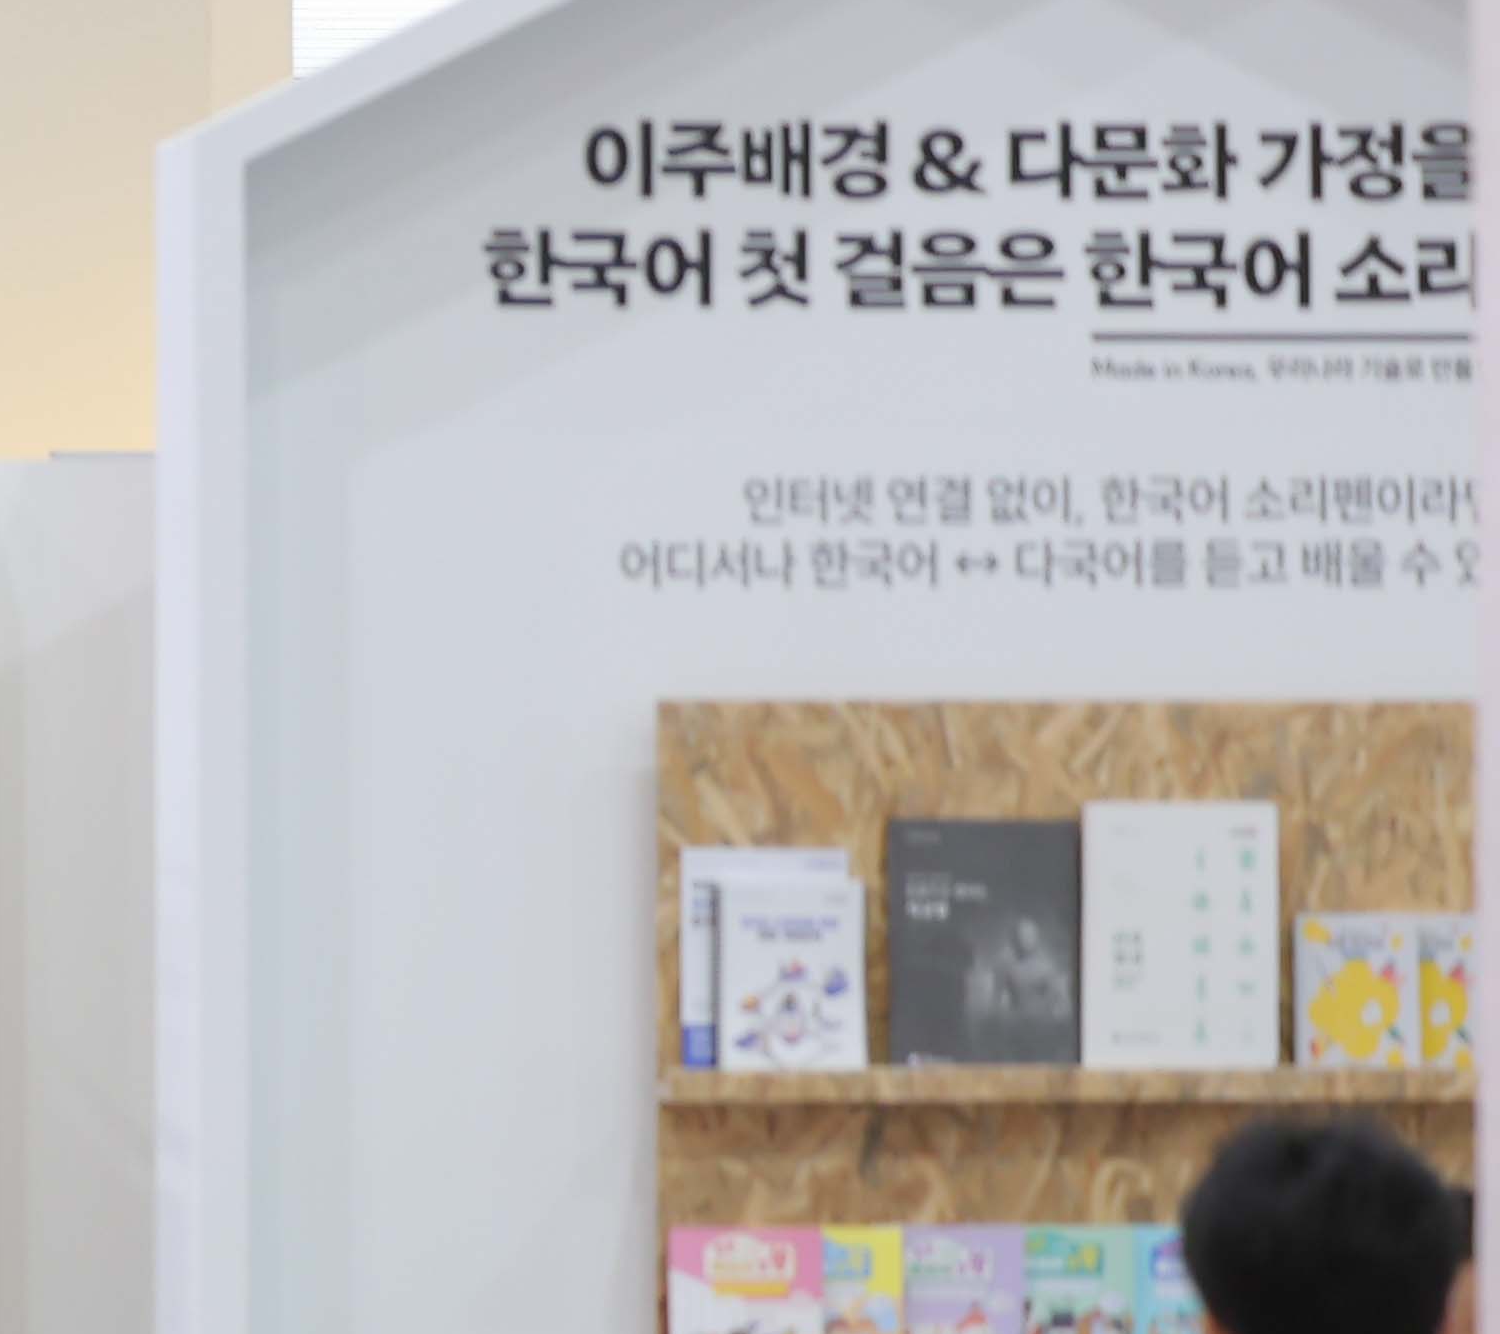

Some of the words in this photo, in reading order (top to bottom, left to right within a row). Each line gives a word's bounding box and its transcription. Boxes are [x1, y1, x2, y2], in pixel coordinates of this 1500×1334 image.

[585, 118, 892, 202] 이주배경
[912, 129, 987, 195] &
[1008, 118, 1237, 202] 다문화
[482, 227, 714, 310] 한국어
[737, 230, 810, 309] 첫
[831, 227, 1064, 310] 걸음은
[1084, 227, 1313, 310] 한국어
[744, 475, 875, 526] 인터넷
[886, 475, 974, 526] 연결
[1101, 475, 1230, 526] 한국어
[619, 538, 797, 590] 어디서나
[809, 538, 939, 590] 한국어
